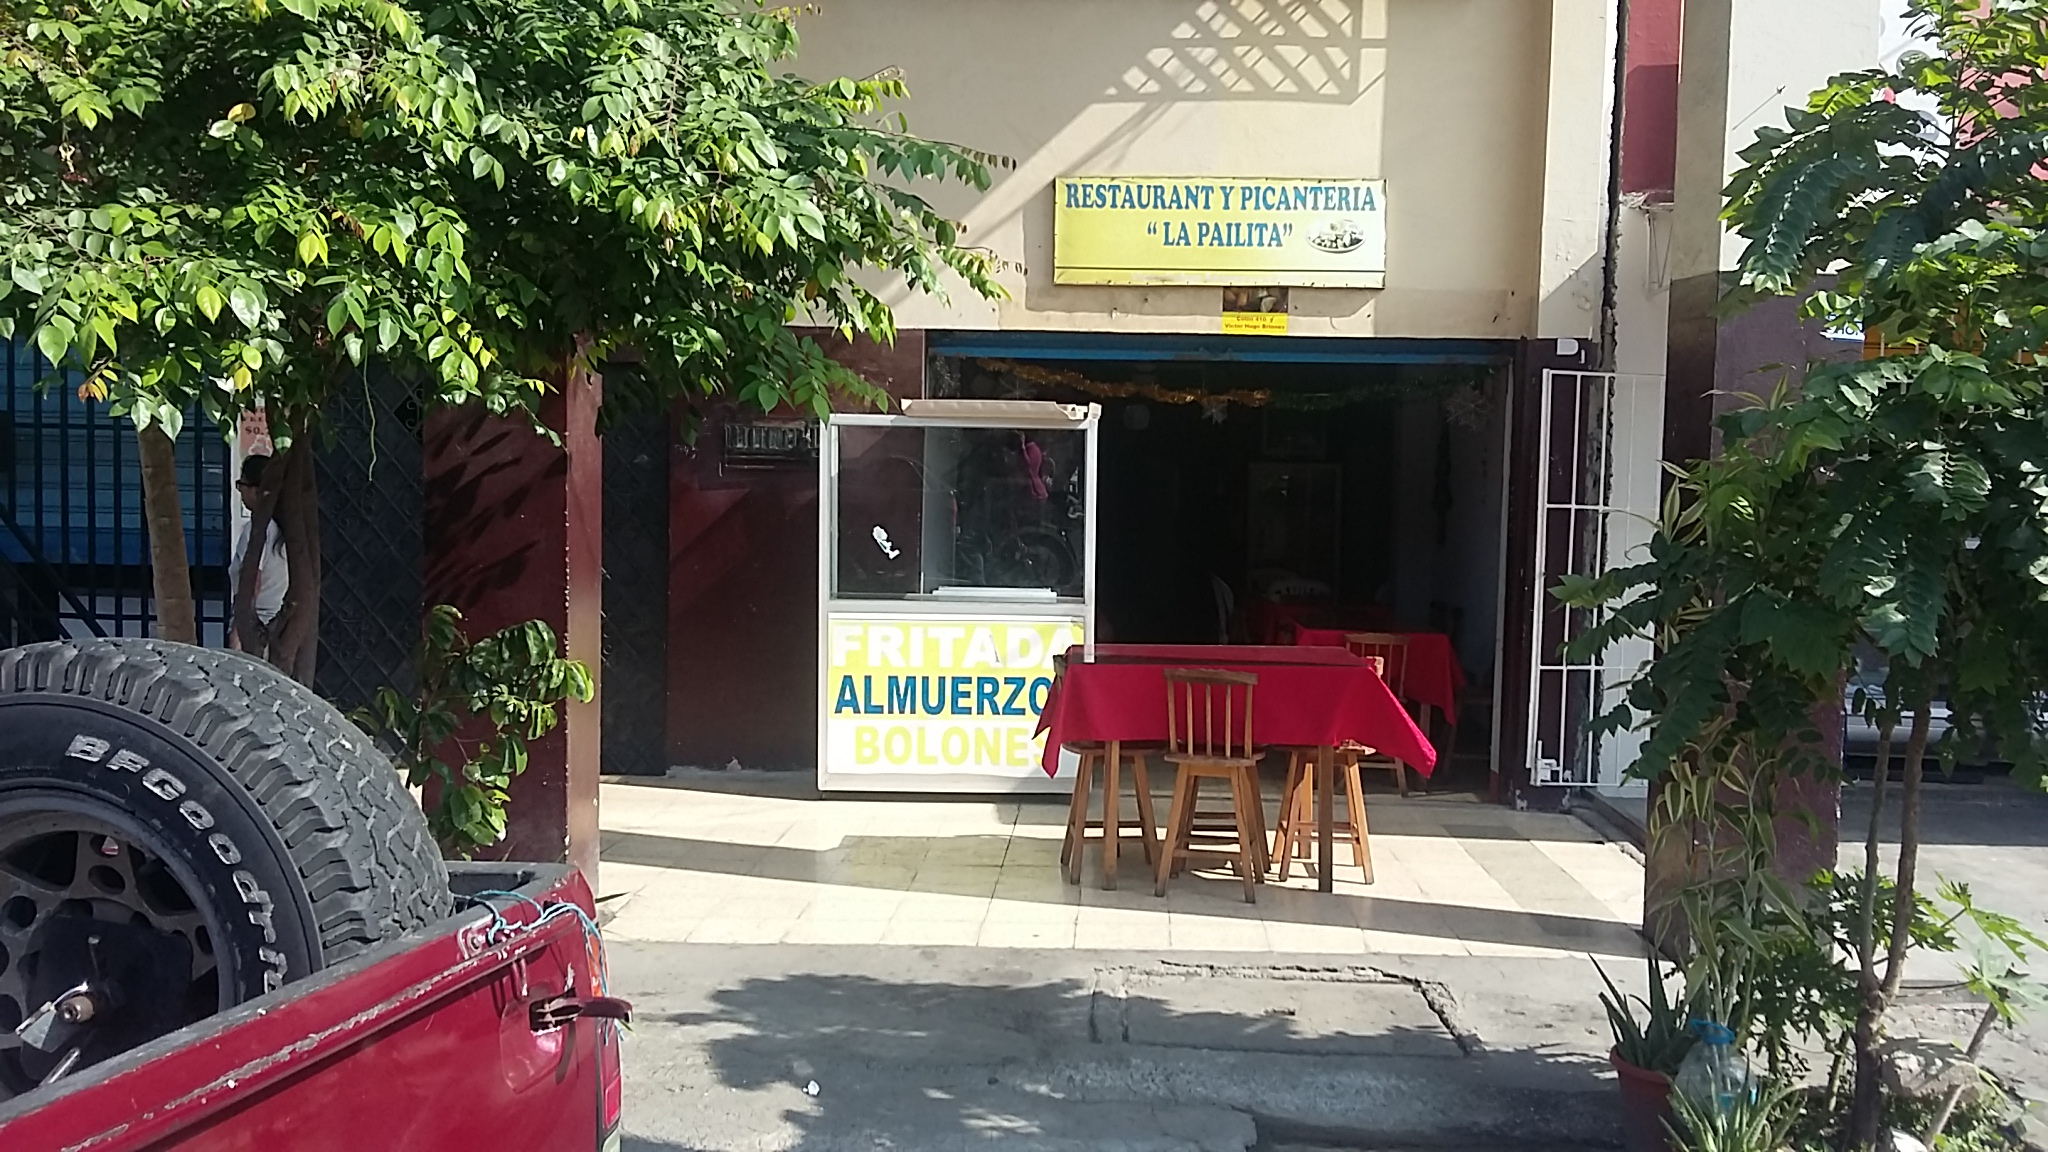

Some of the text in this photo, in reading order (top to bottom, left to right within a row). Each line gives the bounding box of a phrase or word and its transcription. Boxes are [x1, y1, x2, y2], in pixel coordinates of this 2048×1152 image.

[1065, 184, 1377, 211] RESTAURANT Y PICANTERIA
